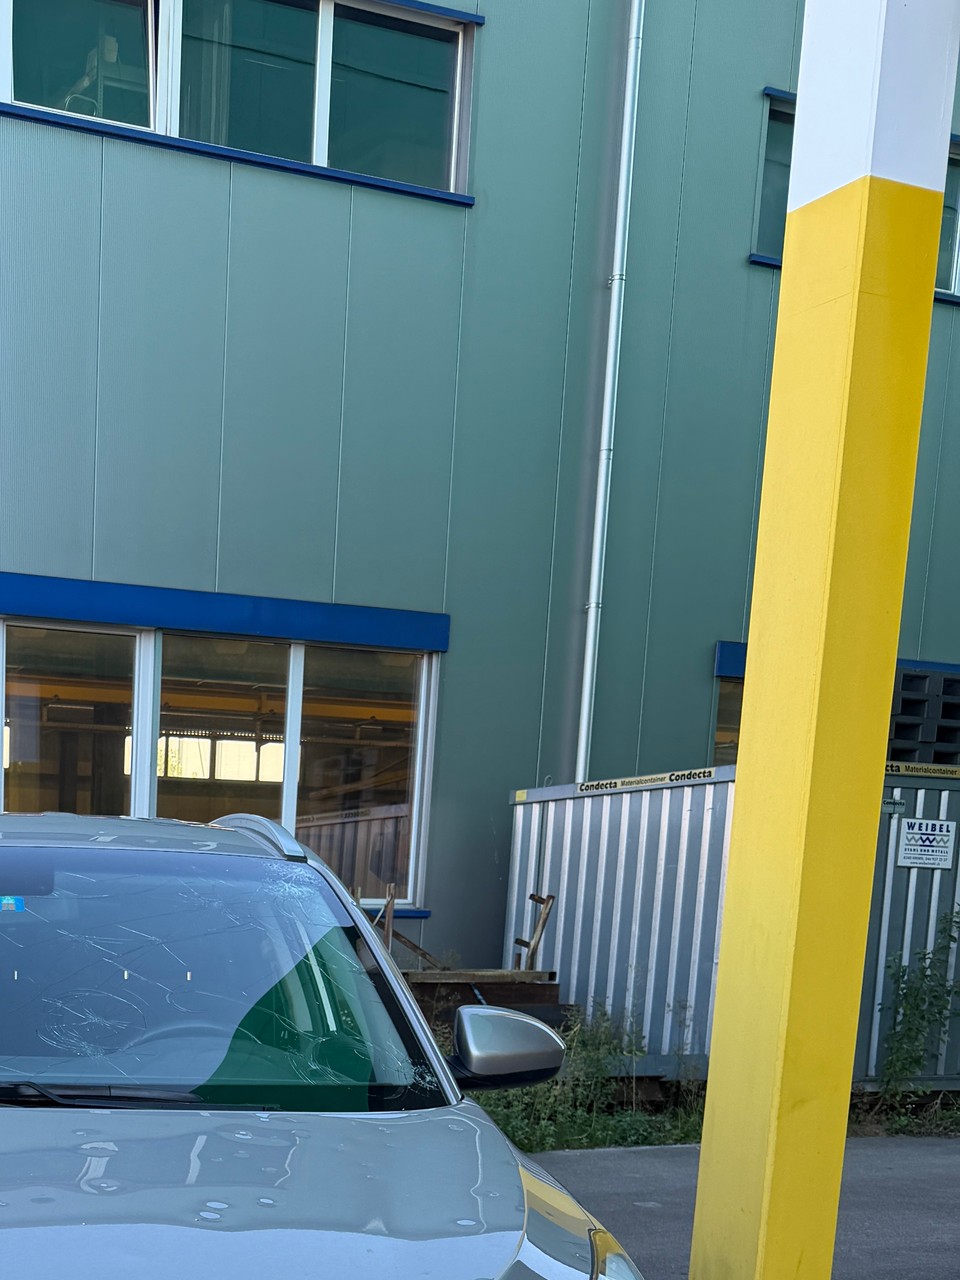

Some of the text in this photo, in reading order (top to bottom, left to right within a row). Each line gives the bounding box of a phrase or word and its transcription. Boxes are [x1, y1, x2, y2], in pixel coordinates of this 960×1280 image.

[904, 765, 958, 776] Materialcontainer
[579, 769, 712, 792] Condecta Materialcontainer Condecta
[907, 821, 950, 833] WEIBEL
